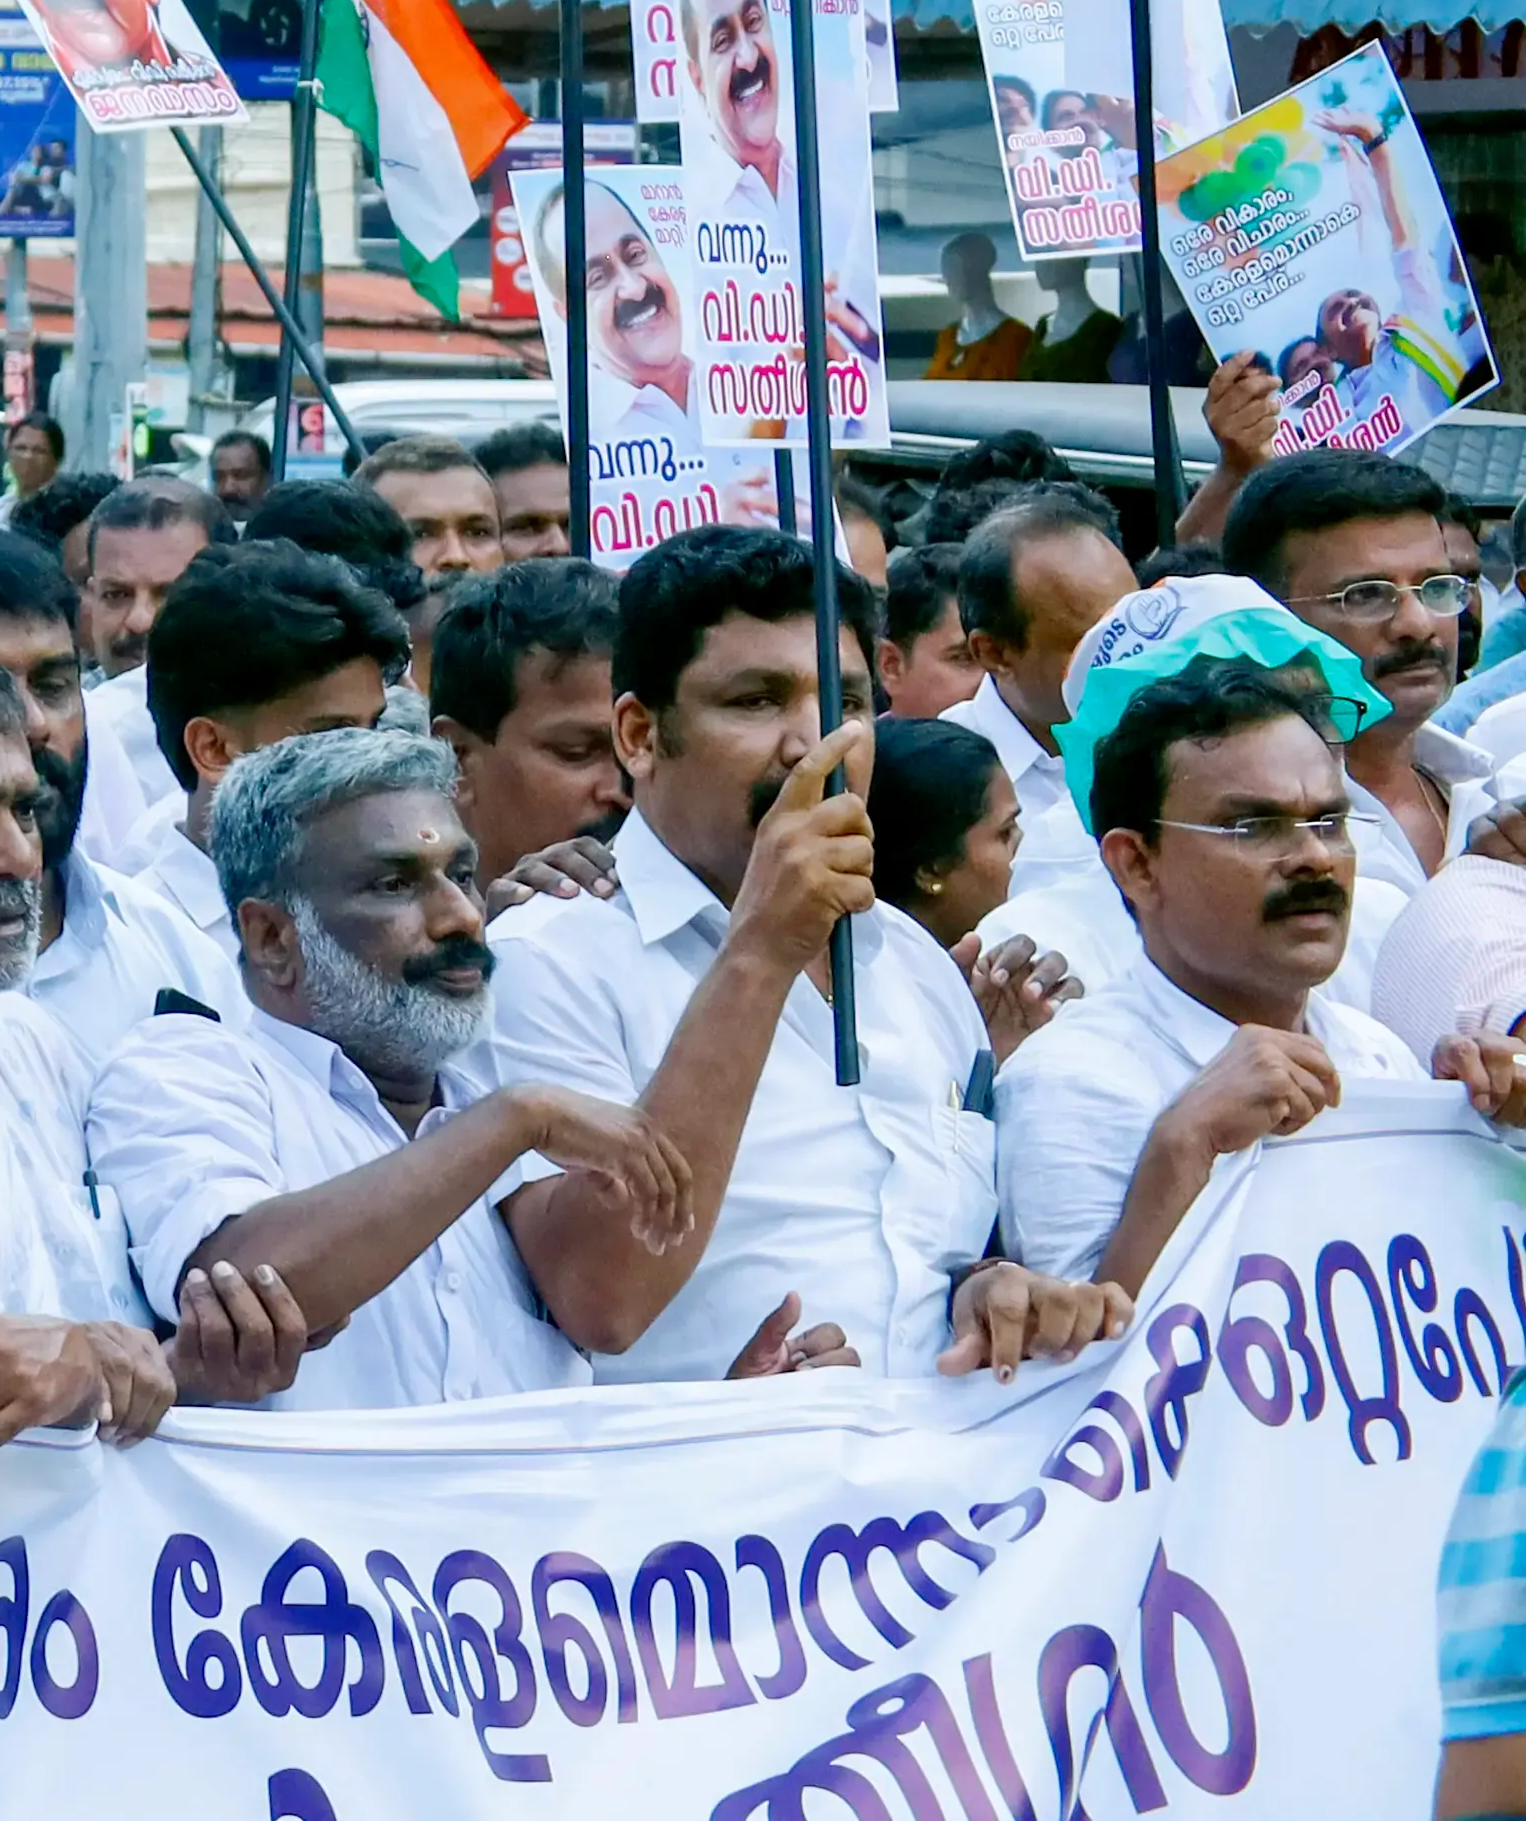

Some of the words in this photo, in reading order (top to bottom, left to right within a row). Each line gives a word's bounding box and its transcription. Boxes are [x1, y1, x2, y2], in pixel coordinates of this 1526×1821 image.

[1015, 148, 1113, 200] വി.ഡി.
[697, 217, 789, 274] വന്നു...
[1024, 195, 1143, 245] സതീശ
[1171, 223, 1215, 257] ഒരേ
[1216, 185, 1295, 237] വികാരം,
[1182, 247, 1225, 279] ഒരേ
[1226, 208, 1310, 259] വിചാരം...
[1195, 201, 1362, 304] കേരളമൊന്നാകെ
[1206, 298, 1243, 327] ഒറ്റ
